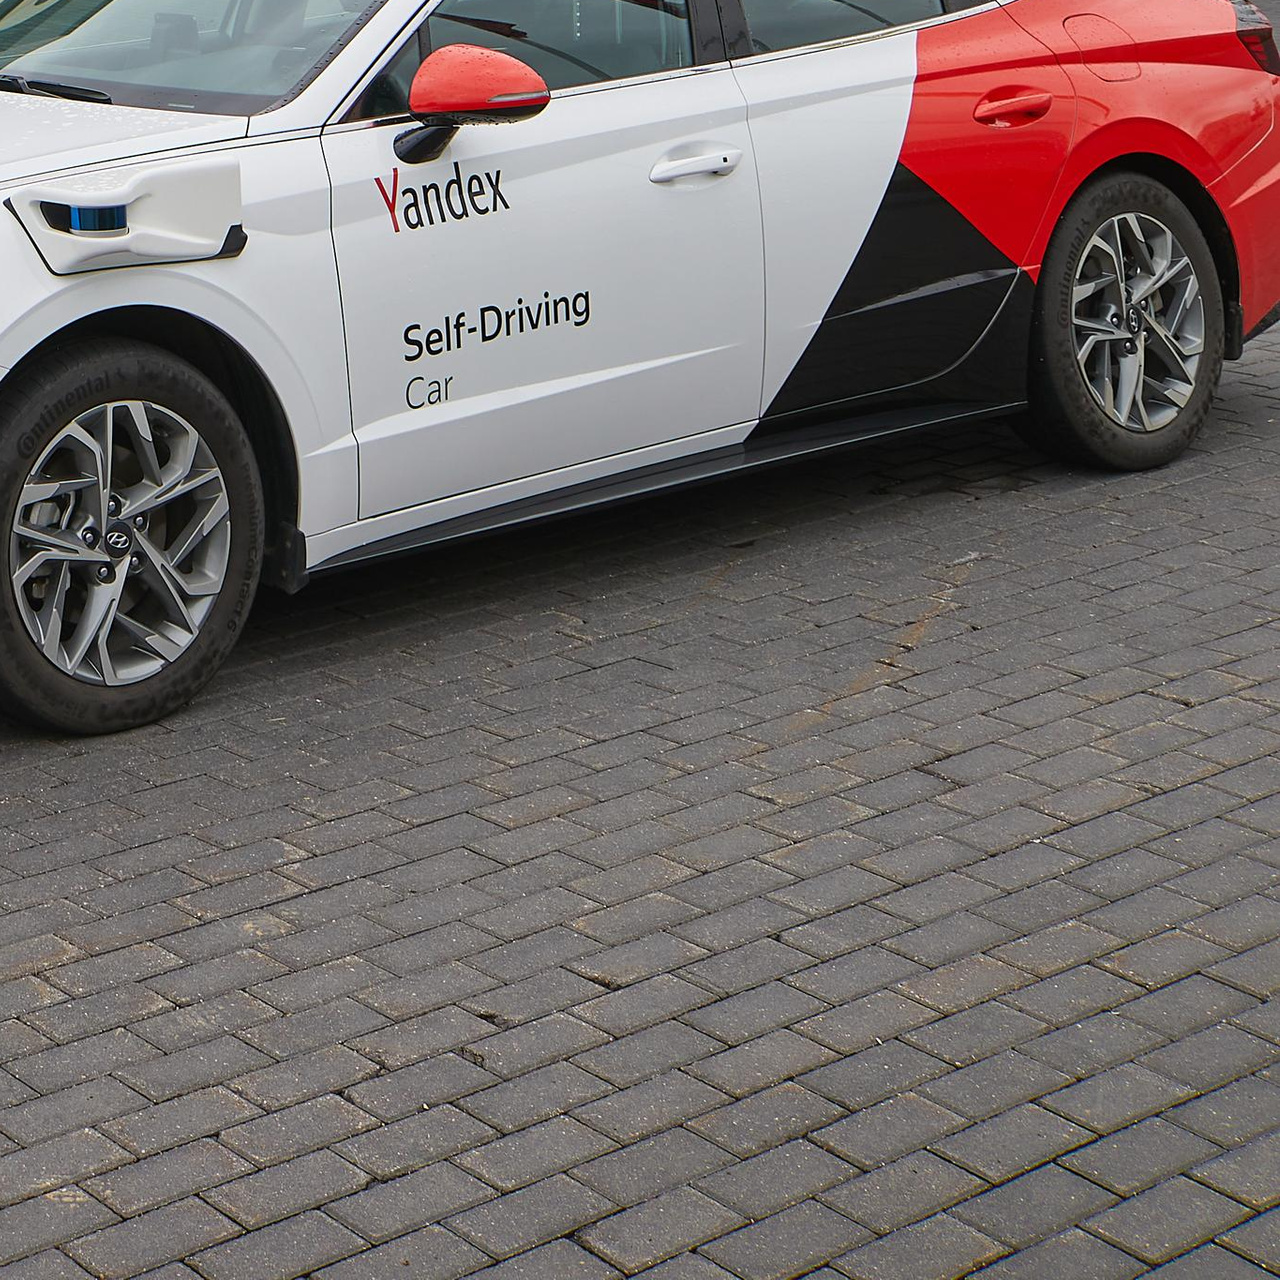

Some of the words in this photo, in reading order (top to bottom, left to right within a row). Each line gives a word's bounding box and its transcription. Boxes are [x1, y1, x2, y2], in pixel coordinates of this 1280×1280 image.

[374, 161, 511, 234] Yandex
[403, 290, 592, 363] Self-Driving
[405, 374, 454, 411] Car
